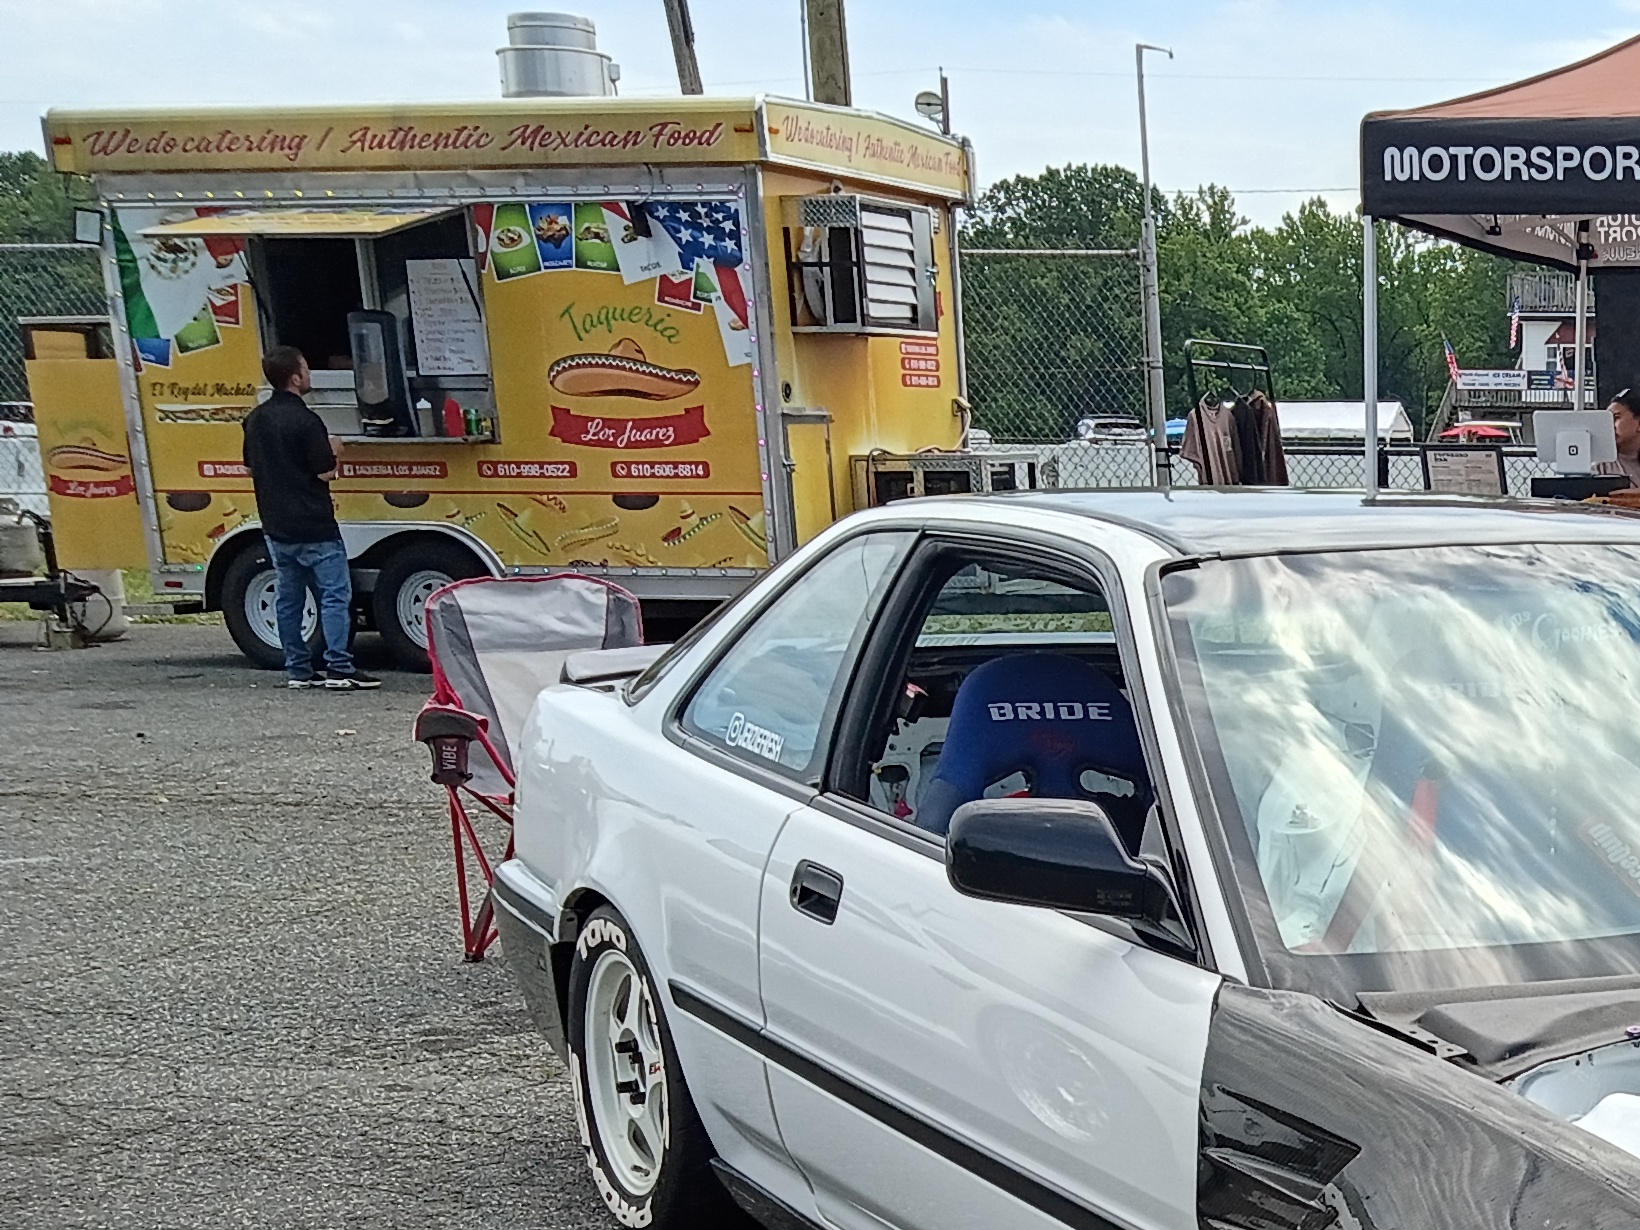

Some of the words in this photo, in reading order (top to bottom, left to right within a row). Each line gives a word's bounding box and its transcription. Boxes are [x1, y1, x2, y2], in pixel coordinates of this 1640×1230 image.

[316, 126, 334, 151] /
[340, 121, 495, 155] Authentic
[499, 122, 646, 152] Mexican
[648, 120, 725, 148] Food
[864, 133, 905, 163] Authentic
[560, 301, 681, 344] Taqueria
[581, 418, 614, 443] Los
[616, 423, 676, 449] Juarez
[988, 702, 1113, 720] BRIDE
[576, 918, 628, 962] TOYO
